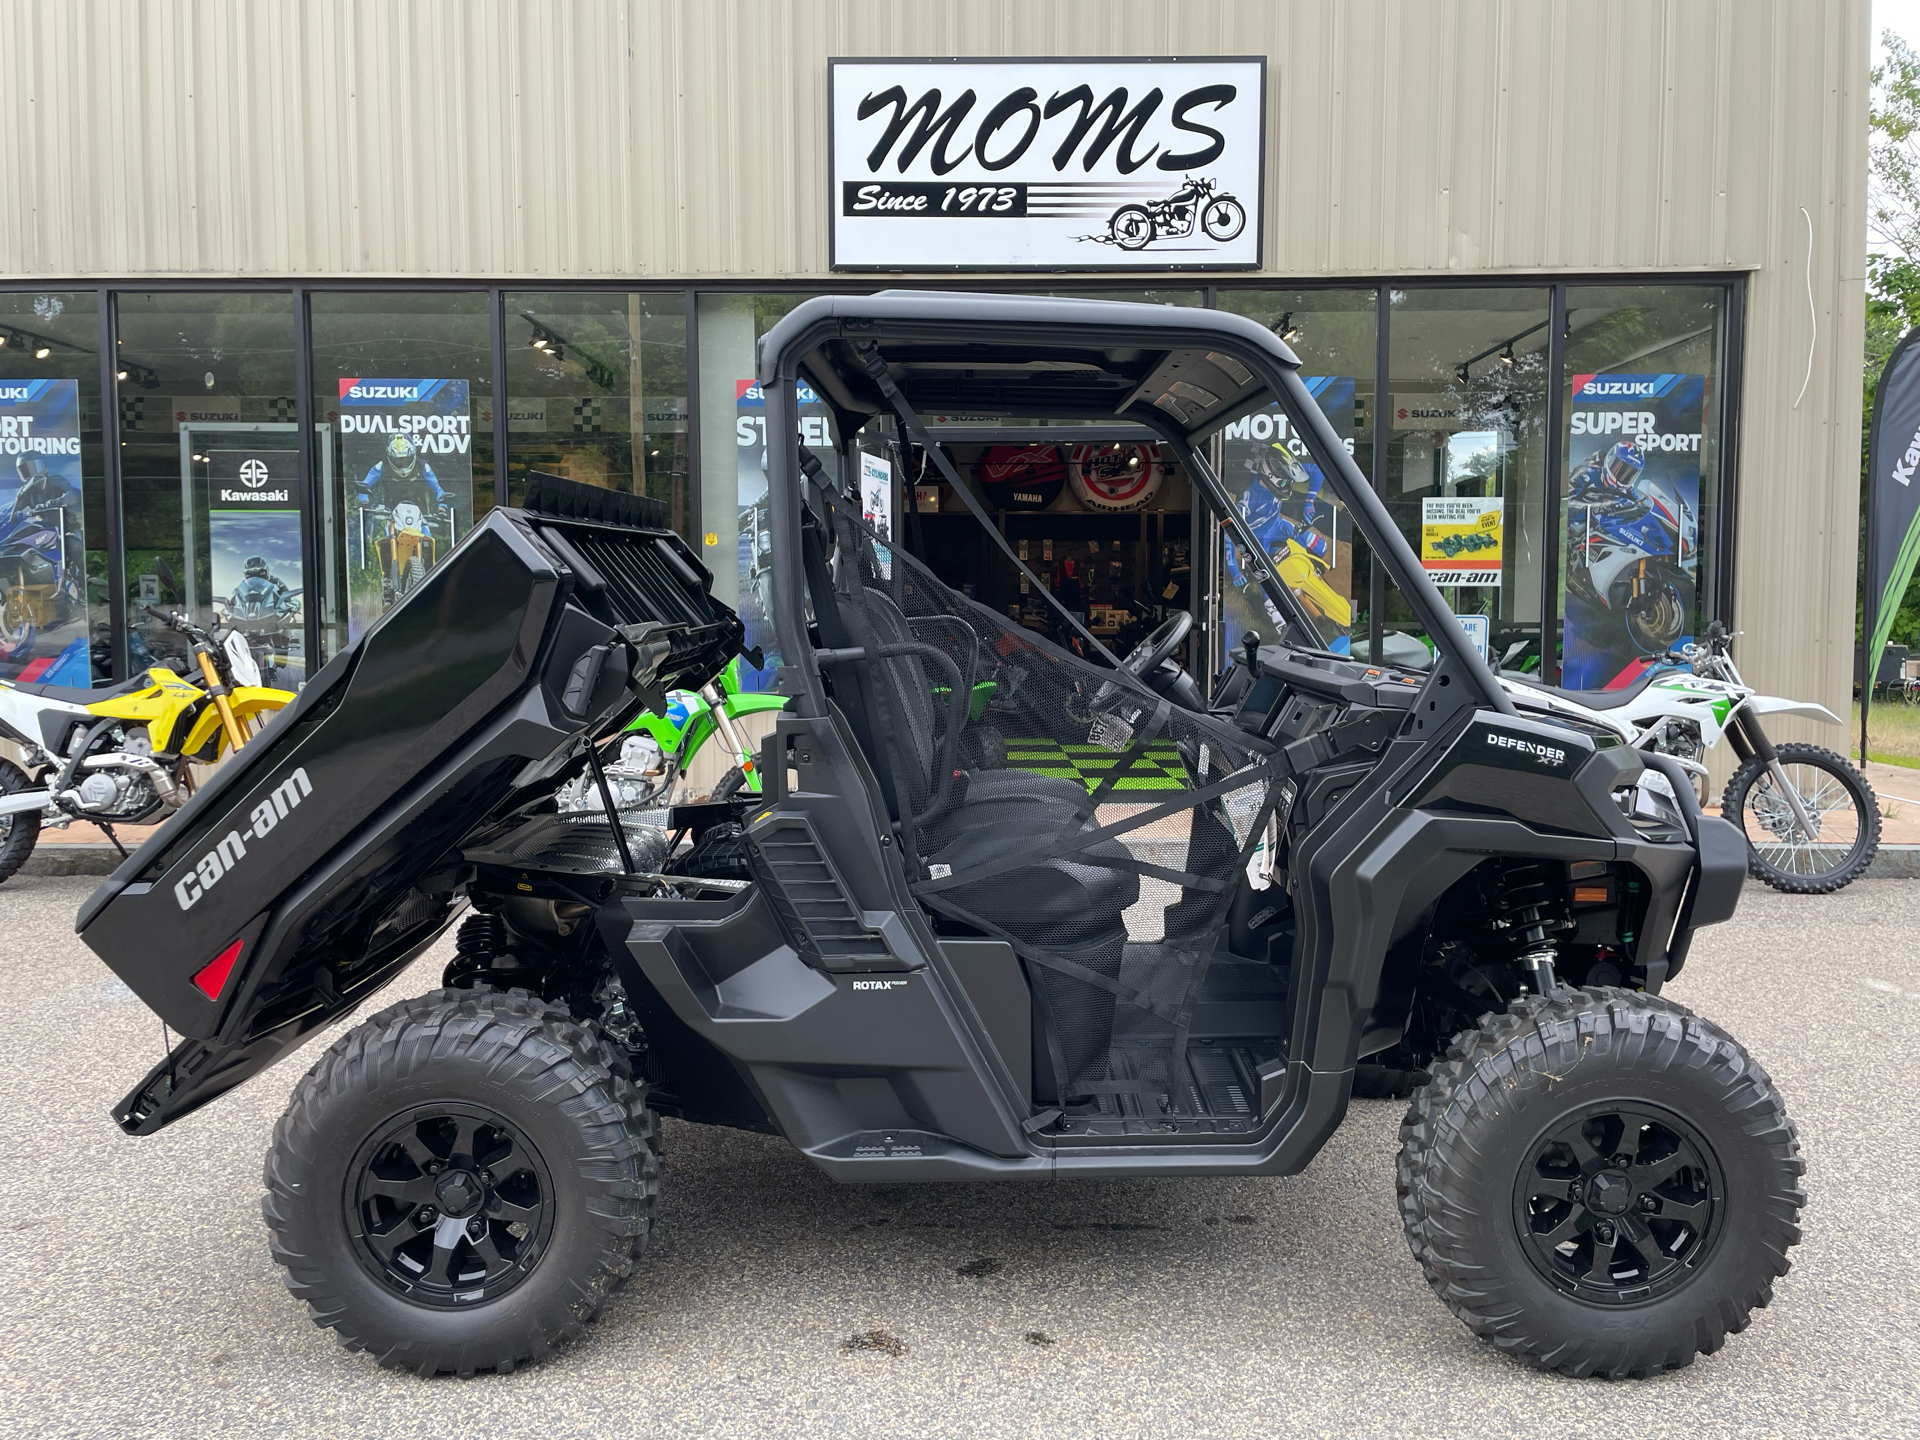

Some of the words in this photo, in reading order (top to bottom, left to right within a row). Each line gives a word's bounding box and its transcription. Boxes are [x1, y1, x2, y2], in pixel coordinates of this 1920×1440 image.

[857, 84, 1237, 176] MOMS
[853, 184, 928, 212] Since
[941, 186, 1016, 212] 1973
[349, 386, 418, 398] SUZUKI
[1582, 383, 1654, 395] SUZUKI
[190, 411, 239, 421] SUZUKI
[507, 411, 543, 421] UZUKI
[647, 413, 688, 422] SUZUK
[1411, 409, 1457, 418] SUZUK
[1570, 412, 1656, 435] SUPER
[1634, 433, 1702, 452] SPORT
[221, 489, 289, 501] Kawasaki
[1013, 492, 1043, 503] YAMAHA
[1085, 491, 1155, 513] AIRHEAD
[1481, 520, 1496, 529] EVENT
[1618, 527, 1645, 547] SUZUKI
[1463, 623, 1477, 631] ARE
[1487, 733, 1565, 760] DEFENDER
[1537, 756, 1564, 766] XT
[174, 766, 313, 911] can-am
[852, 980, 891, 990] ROTAX
